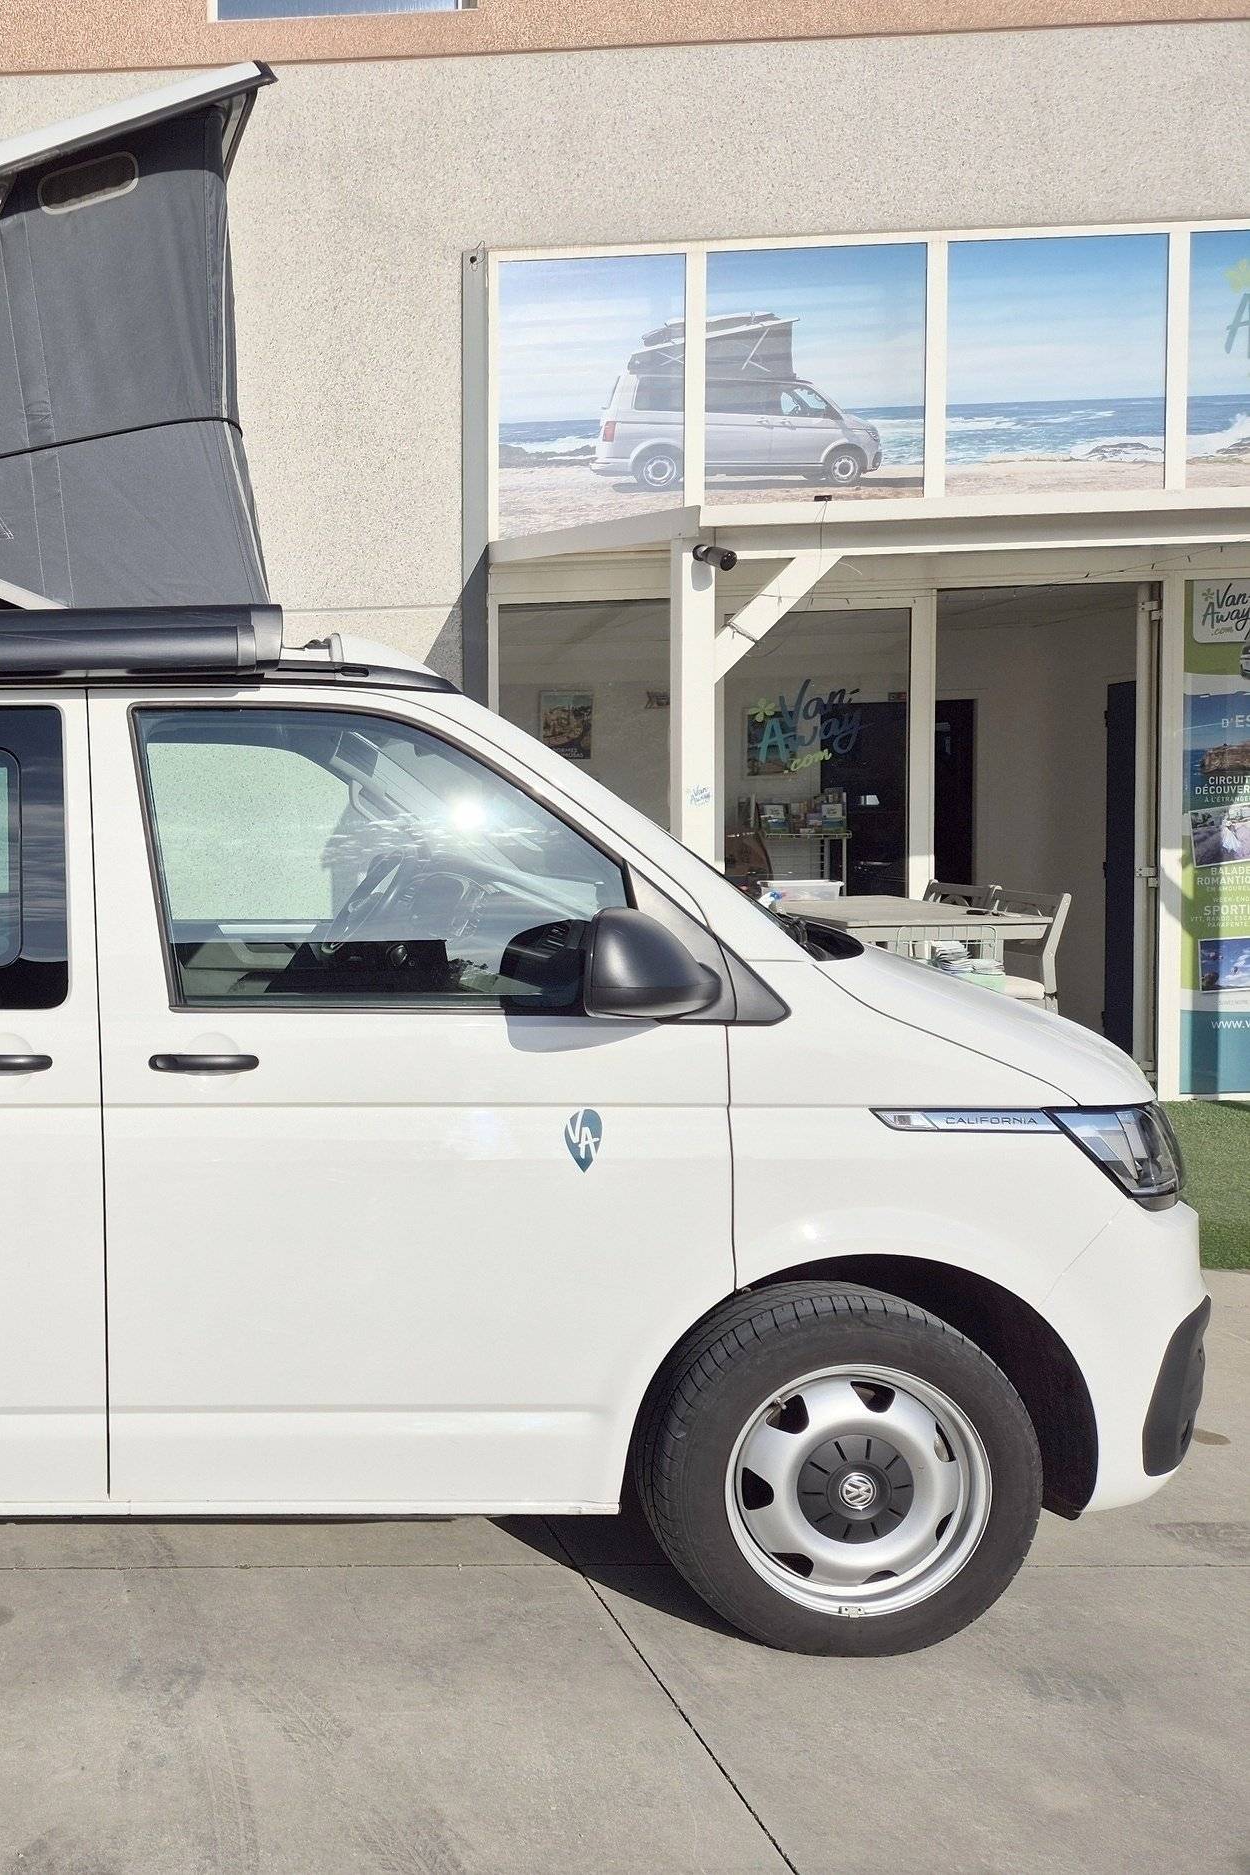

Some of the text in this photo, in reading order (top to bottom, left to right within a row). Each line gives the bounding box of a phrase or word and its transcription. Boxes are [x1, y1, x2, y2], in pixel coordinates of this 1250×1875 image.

[1216, 583, 1250, 609] Van
[778, 679, 860, 728] Van-
[783, 748, 832, 773] .com
[945, 1116, 1038, 1125] CALIFORNIA
